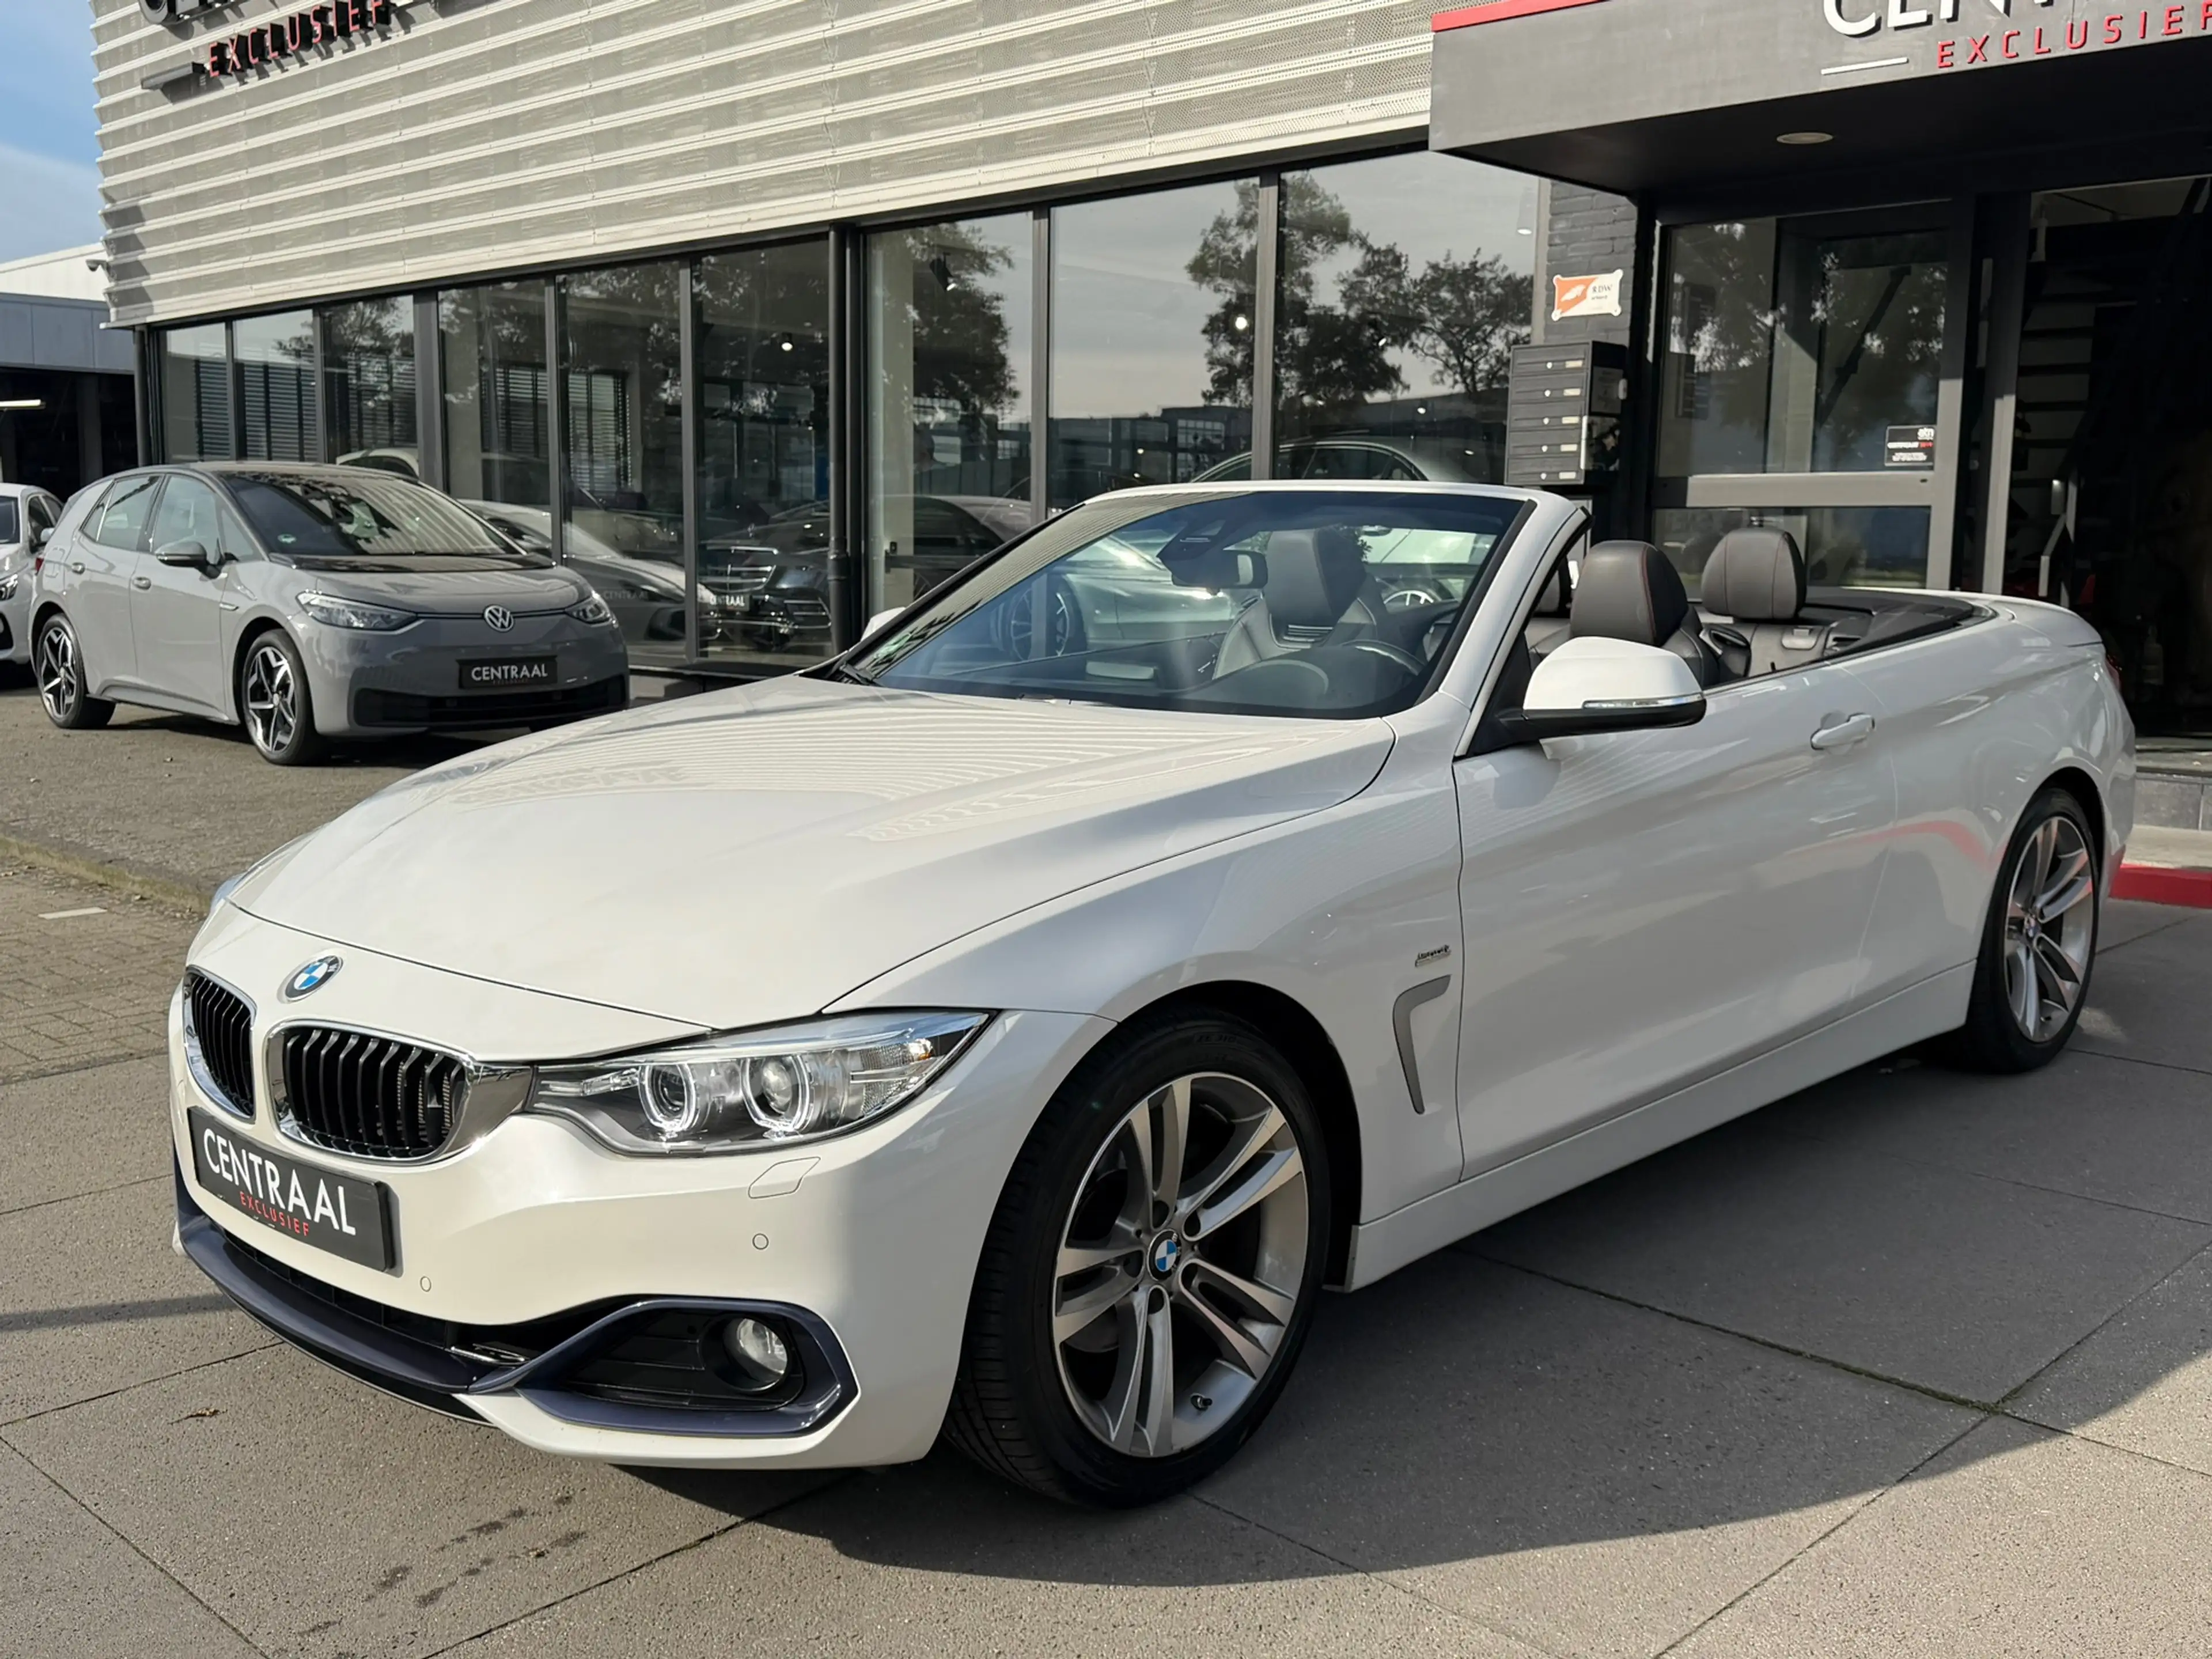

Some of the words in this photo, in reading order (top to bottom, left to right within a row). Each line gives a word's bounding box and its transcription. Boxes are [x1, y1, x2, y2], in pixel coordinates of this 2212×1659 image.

[209, 0, 384, 77] EXCLUSIEF
[1937, 0, 2212, 68] EXCLUSIEF
[471, 664, 548, 681] CENTRAAL
[204, 1128, 356, 1236] CENTRAAL
[240, 1191, 309, 1236] EXCLUSIEF
